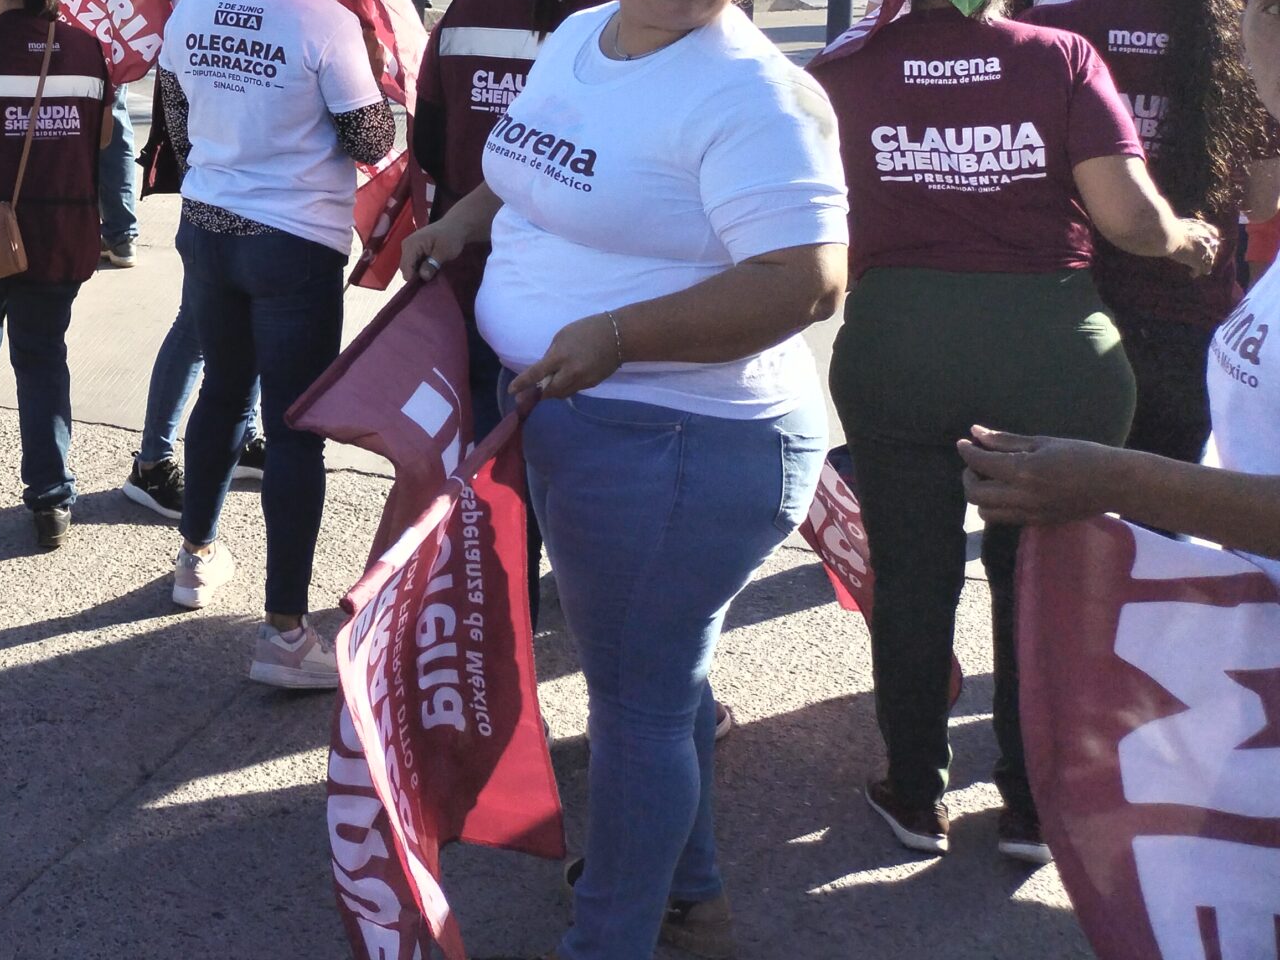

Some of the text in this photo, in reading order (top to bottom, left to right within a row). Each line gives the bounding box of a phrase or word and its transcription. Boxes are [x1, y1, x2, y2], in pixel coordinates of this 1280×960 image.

[225, 3, 236, 11] DE
[237, 4, 264, 15] JUNIO
[217, 11, 259, 30] VOTA
[186, 33, 287, 65] OLEGARIA
[190, 52, 277, 78] CARRAZCO
[903, 57, 1001, 76] morena
[192, 69, 226, 79] DIPUTADA
[228, 73, 242, 82] FED.
[244, 76, 263, 87] DTTO.
[214, 81, 245, 93] SINALOA
[905, 76, 914, 84] La
[916, 77, 957, 85] esperanza
[972, 72, 1001, 82] México
[5, 119, 80, 130] SHENBAUM
[871, 122, 1045, 153] CLAUDIA
[875, 148, 1046, 173] SHEINBAUM
[529, 156, 542, 170] de
[544, 163, 593, 193] México
